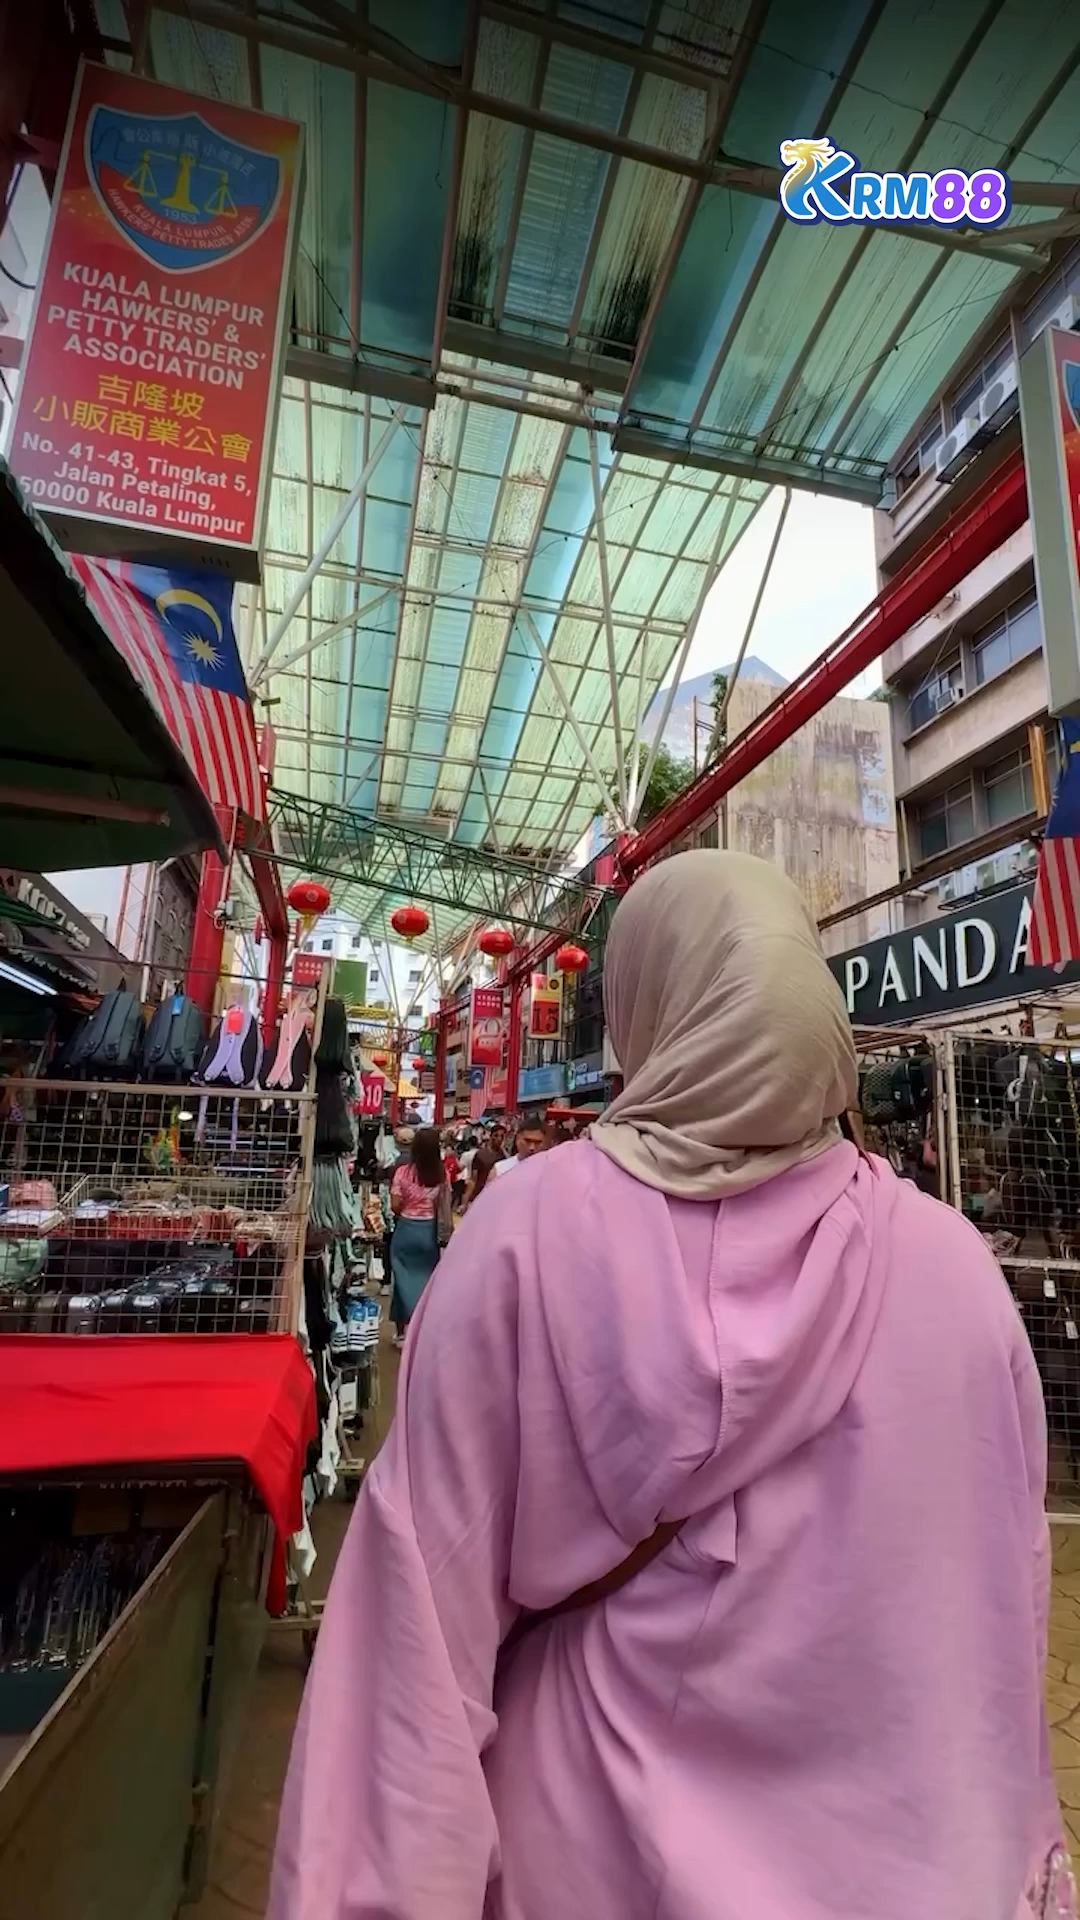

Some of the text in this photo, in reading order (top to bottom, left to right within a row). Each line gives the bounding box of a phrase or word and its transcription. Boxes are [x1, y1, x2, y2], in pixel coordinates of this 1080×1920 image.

[133, 204, 228, 238] KUALA LUMPUR
[153, 227, 191, 247] PETTY
[163, 208, 199, 224] 1953
[63, 262, 264, 327] KUALA LUMPUR
[81, 289, 240, 344] HAWKERS' &
[47, 304, 266, 370] PETTY TRADERS'
[63, 333, 244, 391] ASSOCIATION
[97, 373, 205, 421] 吉隆坡
[32, 395, 253, 463] 小販商業公會
[21, 431, 253, 497] No. 41-43, Tingkat 5,
[54, 462, 217, 511] Jalan Petaling,
[19, 475, 245, 535] 50000 Kuala Lumpur
[365, 1084, 382, 1107] 10
